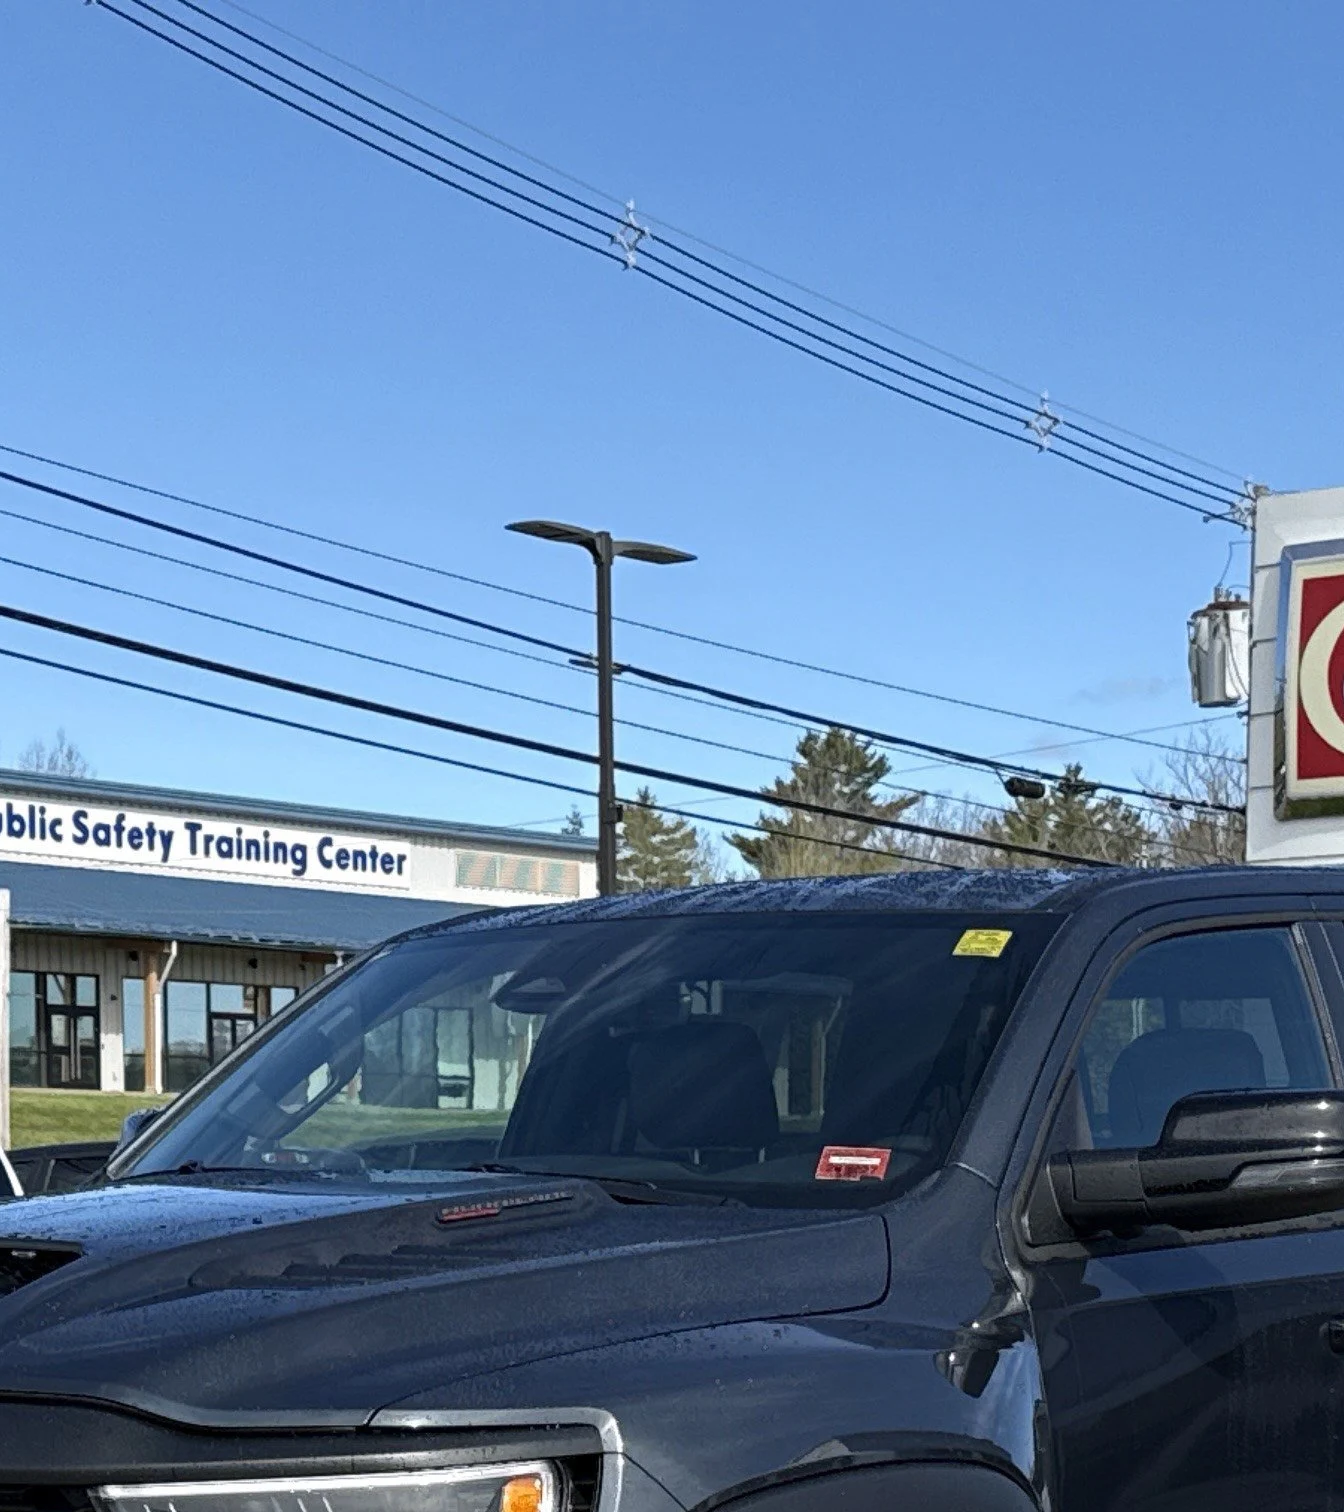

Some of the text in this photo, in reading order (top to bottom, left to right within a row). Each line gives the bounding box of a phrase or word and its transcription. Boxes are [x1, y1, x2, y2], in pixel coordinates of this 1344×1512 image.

[71, 809, 175, 863] Safety
[183, 821, 308, 877] Training
[316, 836, 408, 876] Center
